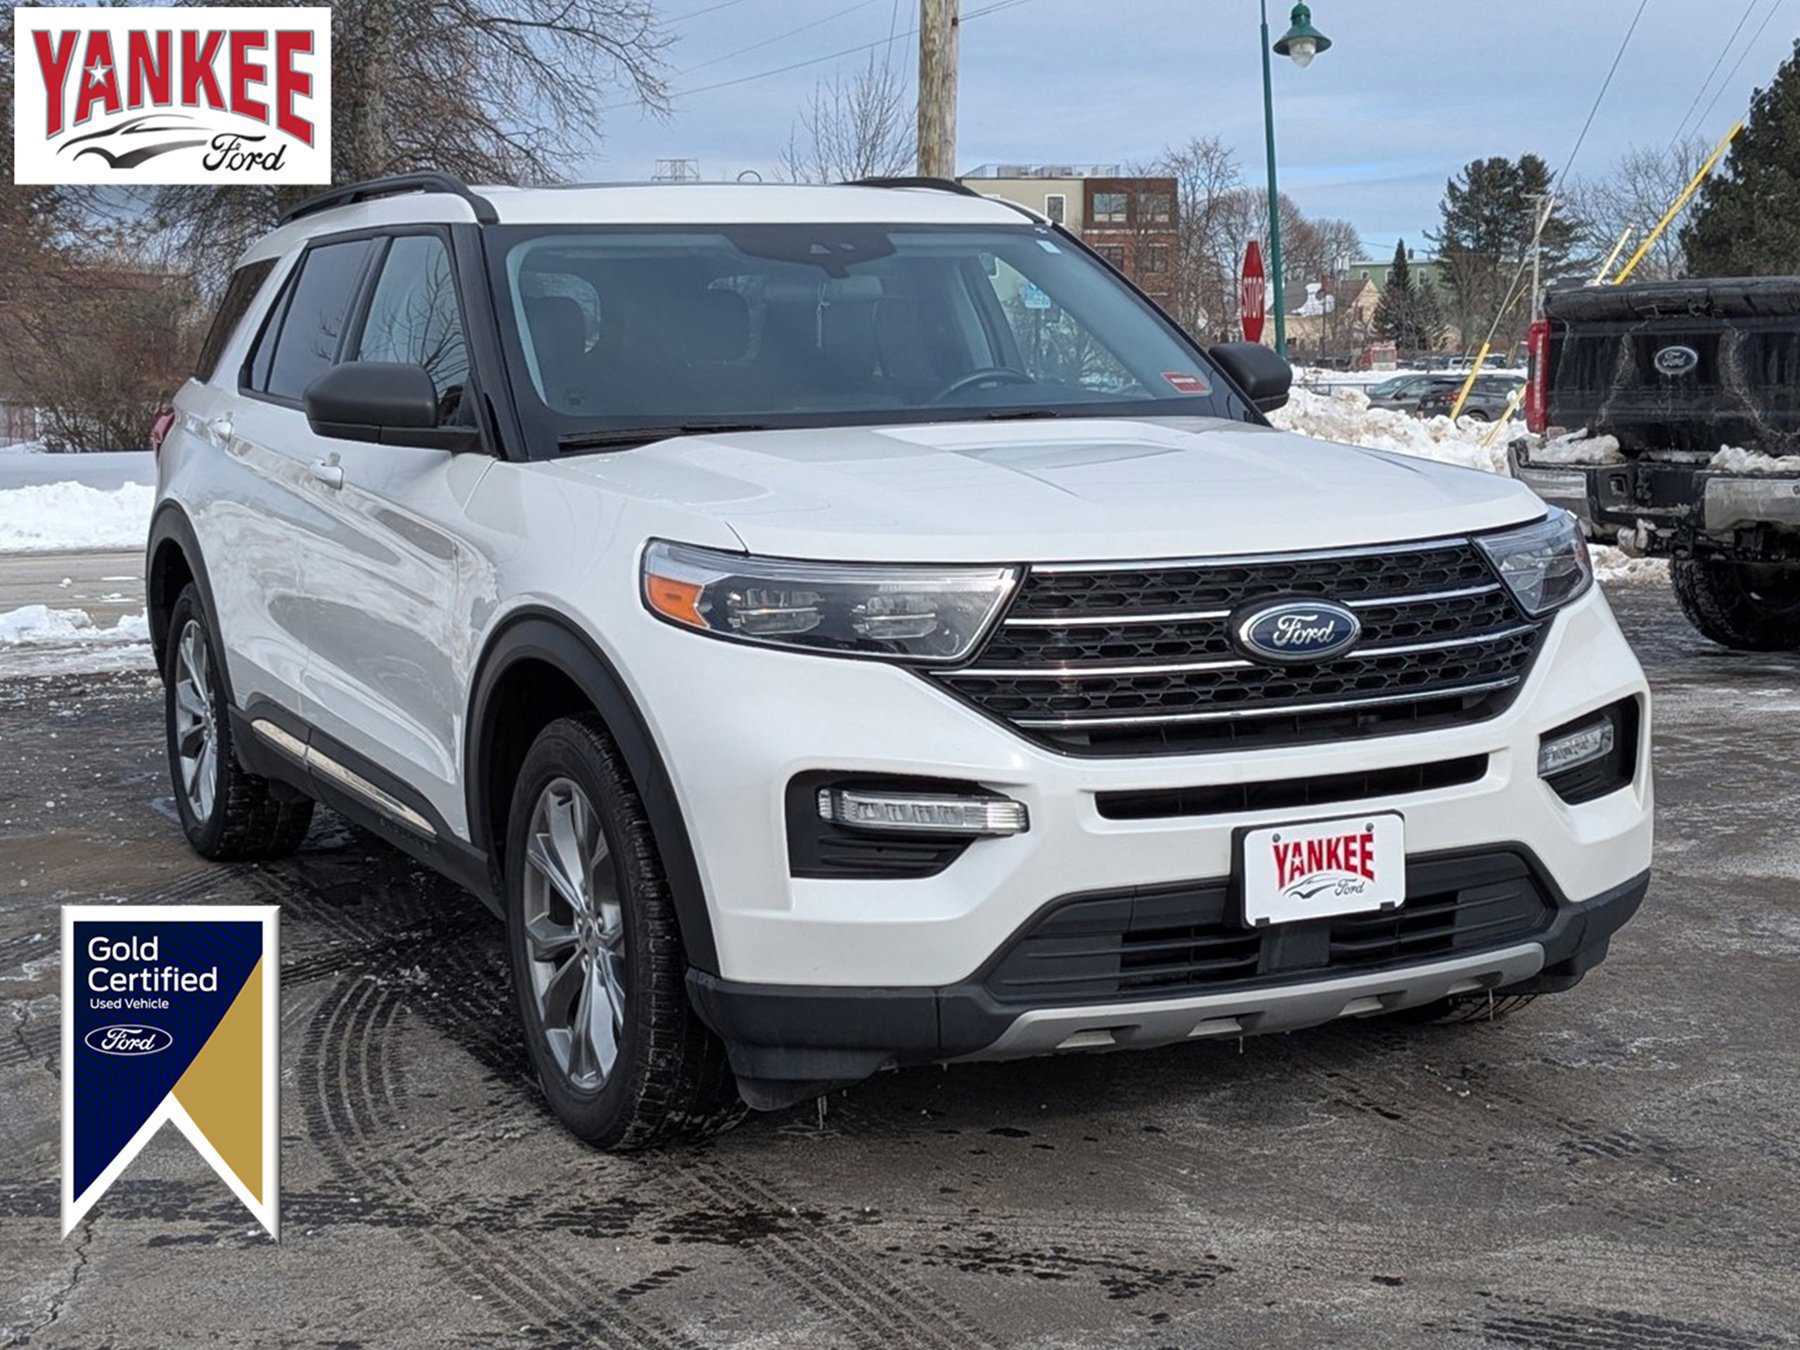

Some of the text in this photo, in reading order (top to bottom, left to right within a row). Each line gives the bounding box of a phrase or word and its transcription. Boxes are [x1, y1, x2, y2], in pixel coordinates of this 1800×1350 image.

[1243, 276, 1263, 319] STOP
[1662, 351, 1687, 367] Ford
[1273, 614, 1335, 646] Ford
[1273, 833, 1375, 890] YANKEE
[1334, 878, 1365, 896] Ford
